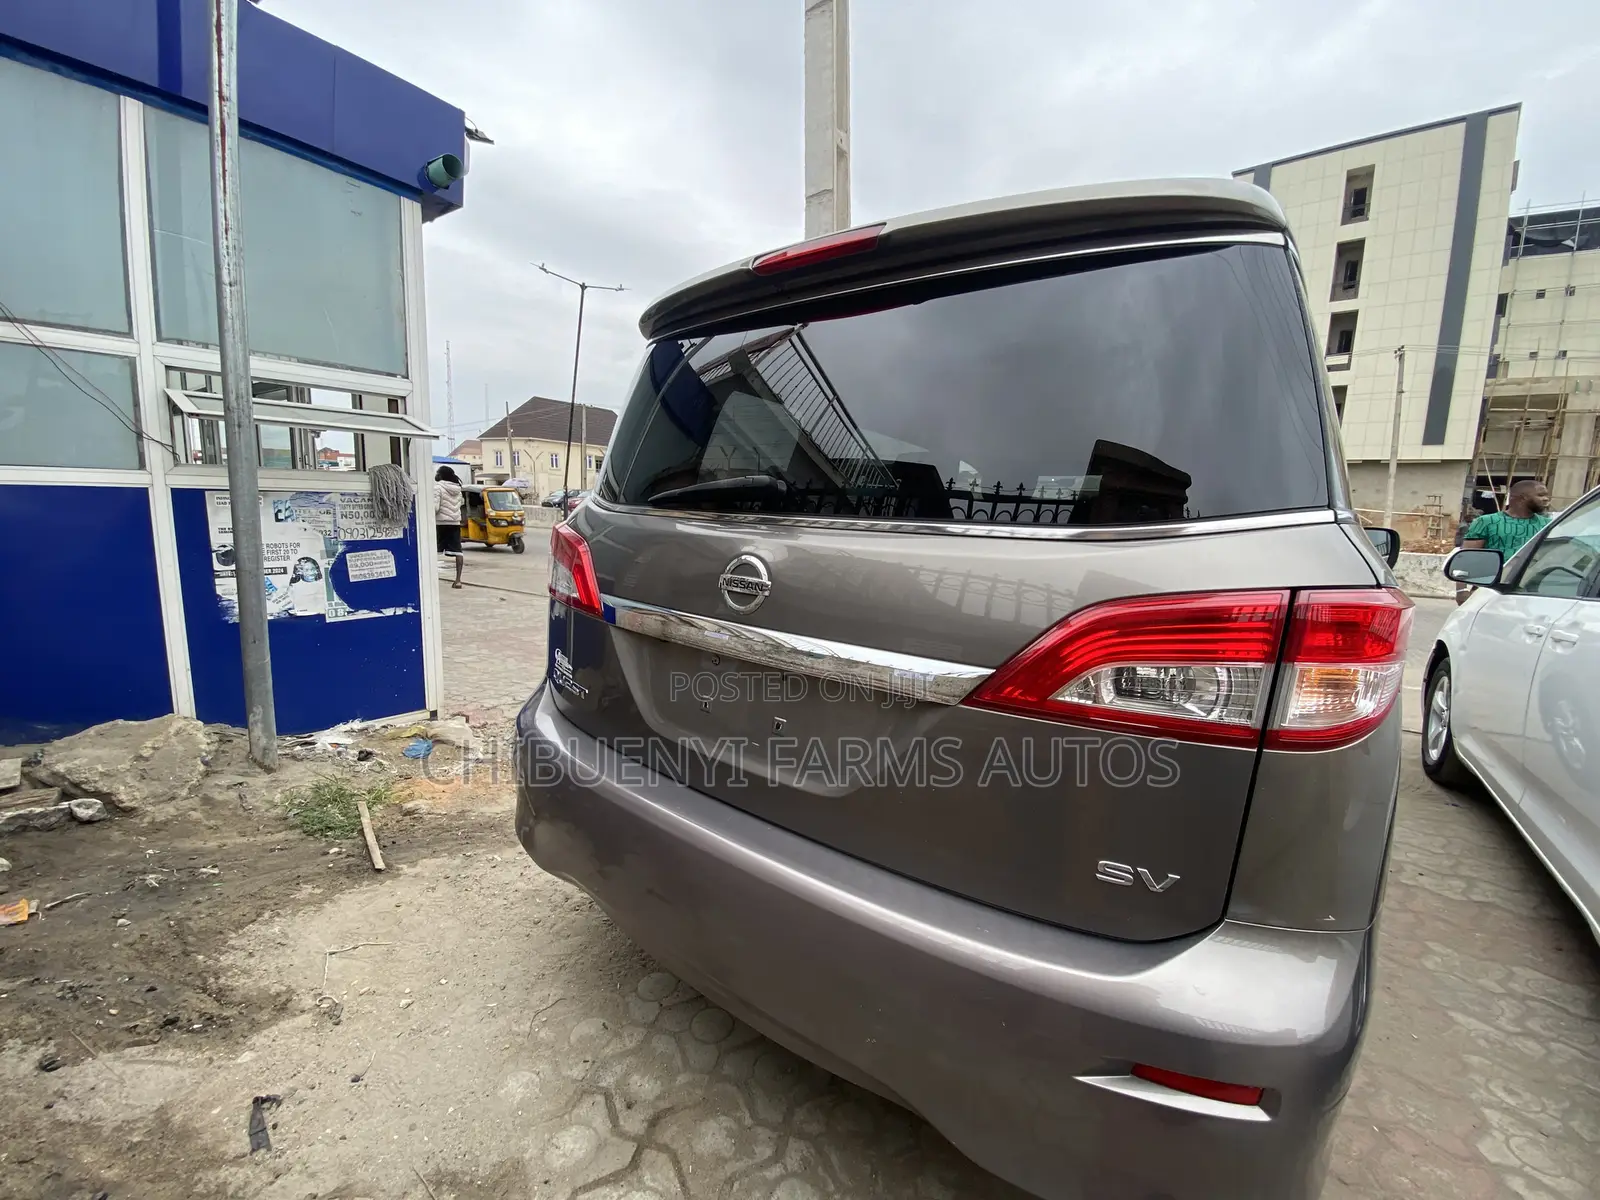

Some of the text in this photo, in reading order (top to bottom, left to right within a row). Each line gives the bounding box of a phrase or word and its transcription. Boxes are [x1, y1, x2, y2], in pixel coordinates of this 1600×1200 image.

[341, 510, 375, 520] N50,00
[723, 577, 764, 592] NISSAN
[1095, 860, 1181, 893] SV
